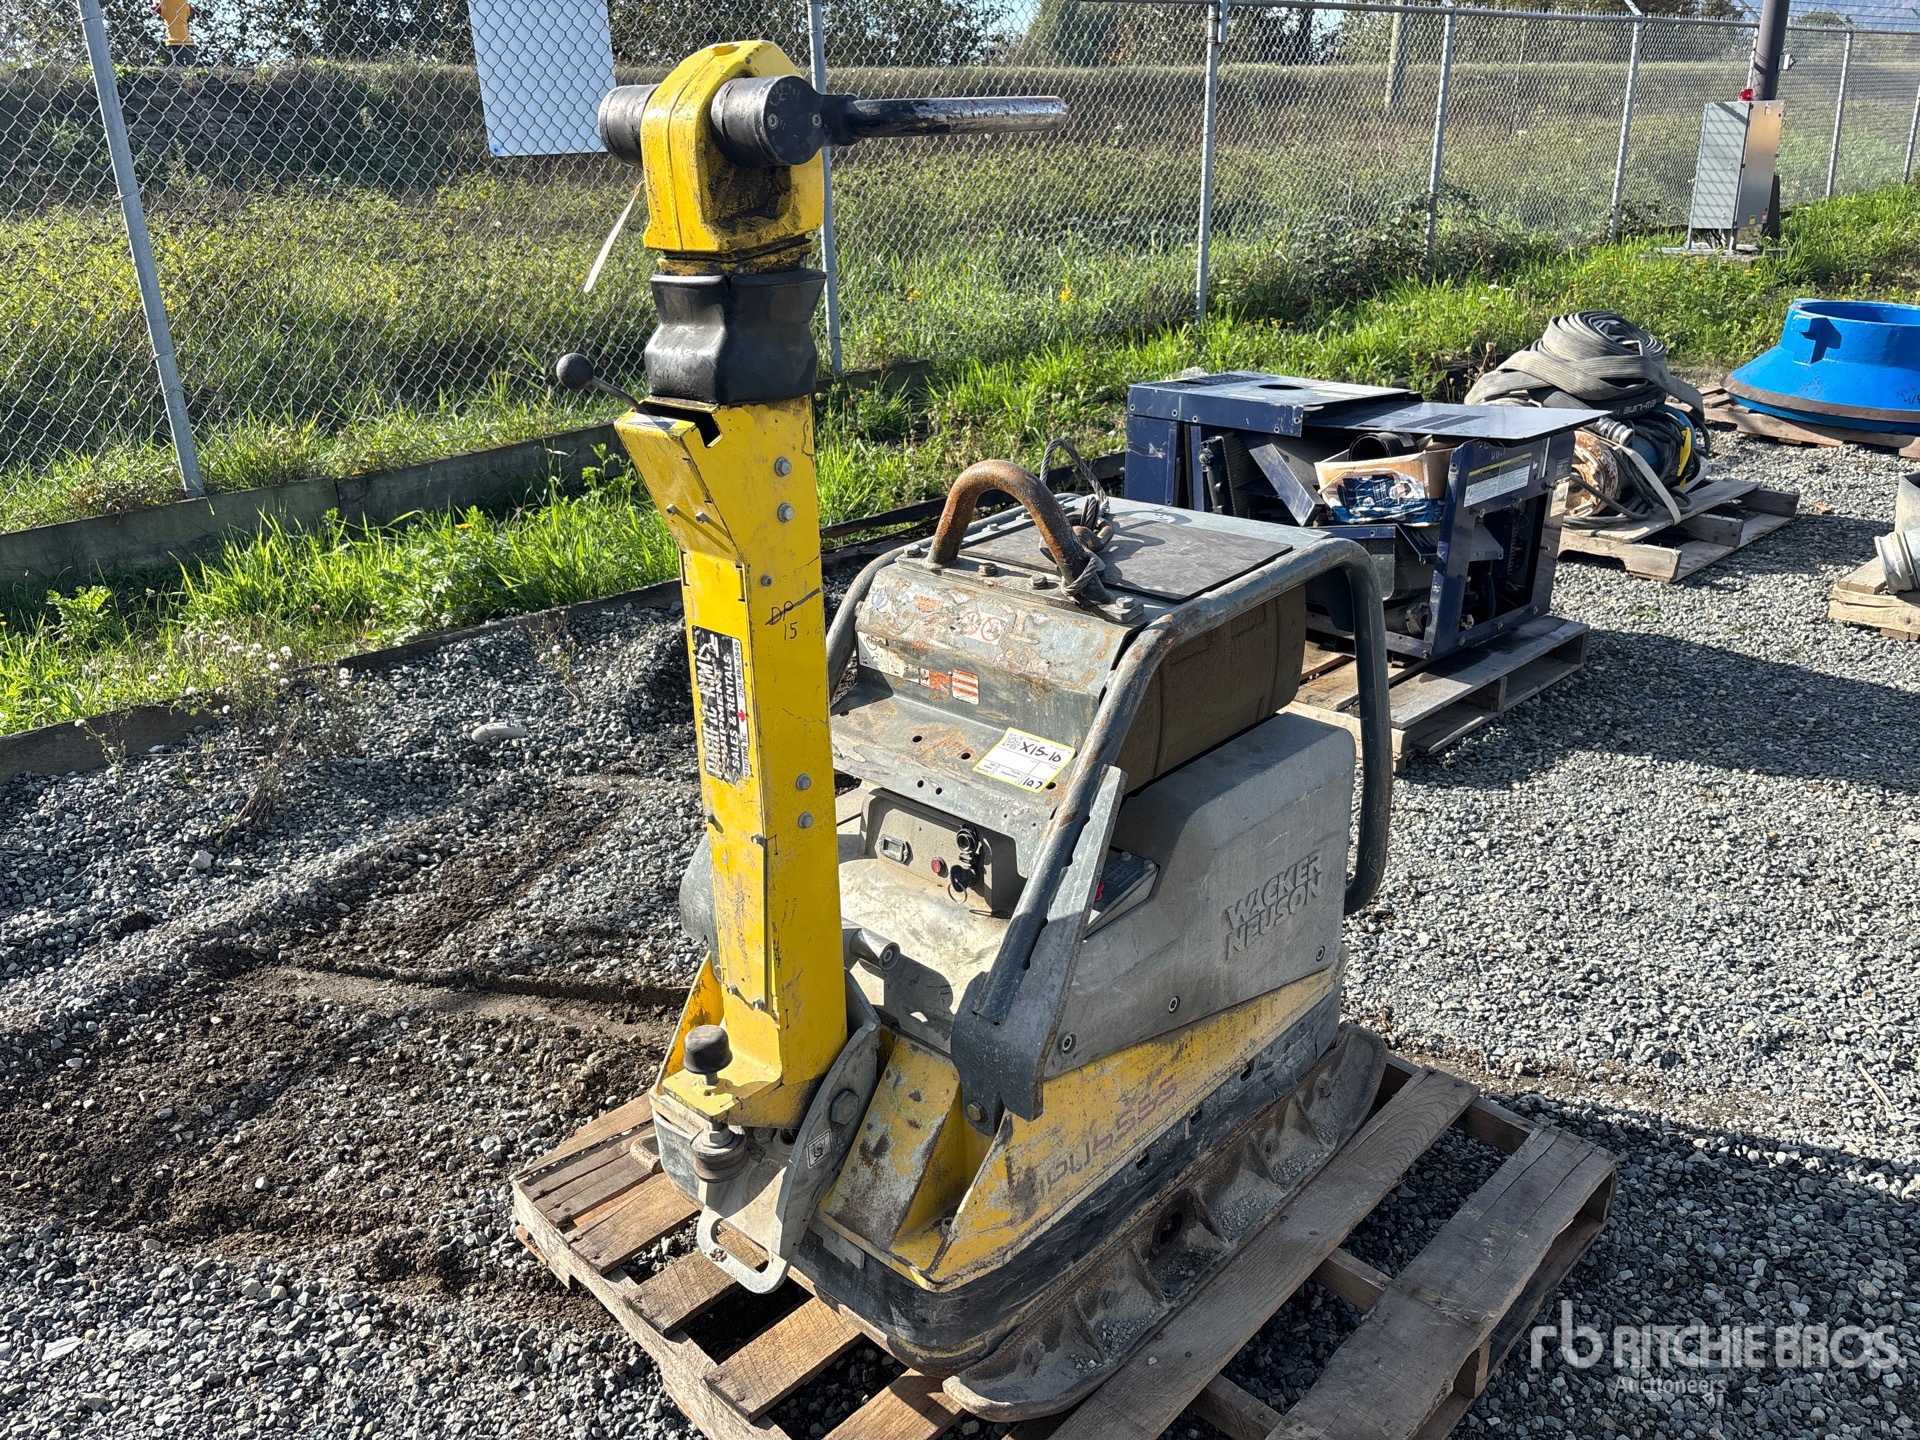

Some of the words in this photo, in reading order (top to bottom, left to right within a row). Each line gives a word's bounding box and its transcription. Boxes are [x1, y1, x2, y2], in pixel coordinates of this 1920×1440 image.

[783, 621, 799, 641] 15
[724, 655, 735, 711] RENTALS
[729, 714, 736, 725] &
[731, 729, 740, 768] SALES
[1020, 741, 1062, 763] X15-10
[1224, 848, 1322, 931] WACKER
[1225, 868, 1322, 961] NEUSON
